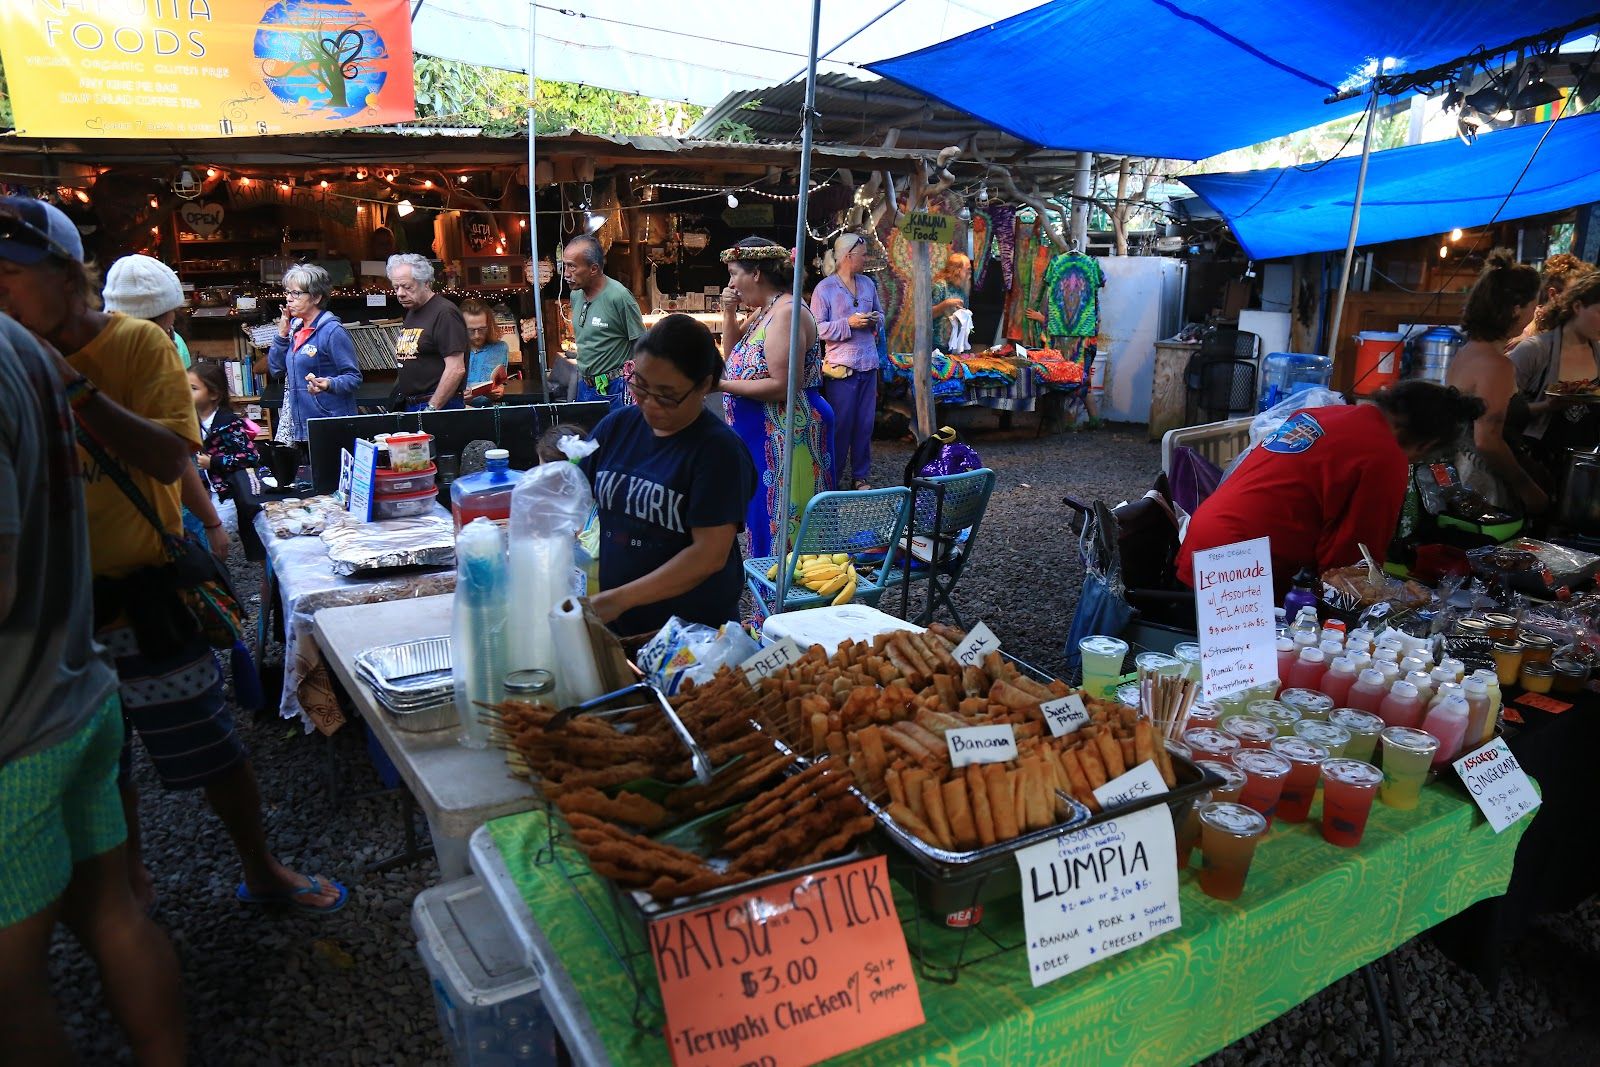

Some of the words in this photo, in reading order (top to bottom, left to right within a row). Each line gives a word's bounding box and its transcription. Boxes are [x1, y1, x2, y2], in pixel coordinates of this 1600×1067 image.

[46, 20, 207, 57] FOODS
[201, 66, 230, 79] FREE
[256, 120, 267, 134] 6
[186, 211, 219, 226] OPEN
[910, 213, 947, 229] KARUNA
[913, 227, 938, 241] Foods
[624, 476, 685, 534] YORK
[1200, 560, 1270, 591] Lemonade
[1221, 585, 1262, 602] Assorted
[754, 645, 791, 677] BEEF
[960, 636, 989, 666] PORK
[1234, 659, 1247, 671] Tea
[1044, 702, 1071, 719] Sweet
[1057, 711, 1085, 728] potato
[951, 735, 1010, 753] Banana
[1463, 748, 1499, 772] ASSORTED
[1466, 755, 1520, 796] GINGERADE
[1106, 780, 1153, 809] CHEESE
[1057, 821, 1117, 848] ASSORTED
[1030, 840, 1149, 904] LUMPIA
[1080, 896, 1094, 906] each
[1099, 892, 1108, 900] or
[1121, 888, 1132, 899] for
[651, 896, 771, 983] KATSU
[790, 864, 890, 945] STICK
[947, 907, 978, 922] HEA
[1040, 928, 1080, 949] BANANA
[1098, 914, 1124, 930] PORK
[1043, 954, 1071, 972] BEEF
[1102, 931, 1140, 951] CHEESE
[740, 955, 818, 999] $3.00
[863, 957, 895, 978] Salt
[680, 1014, 769, 1056] Teriyaki
[775, 989, 853, 1031] Chicken
